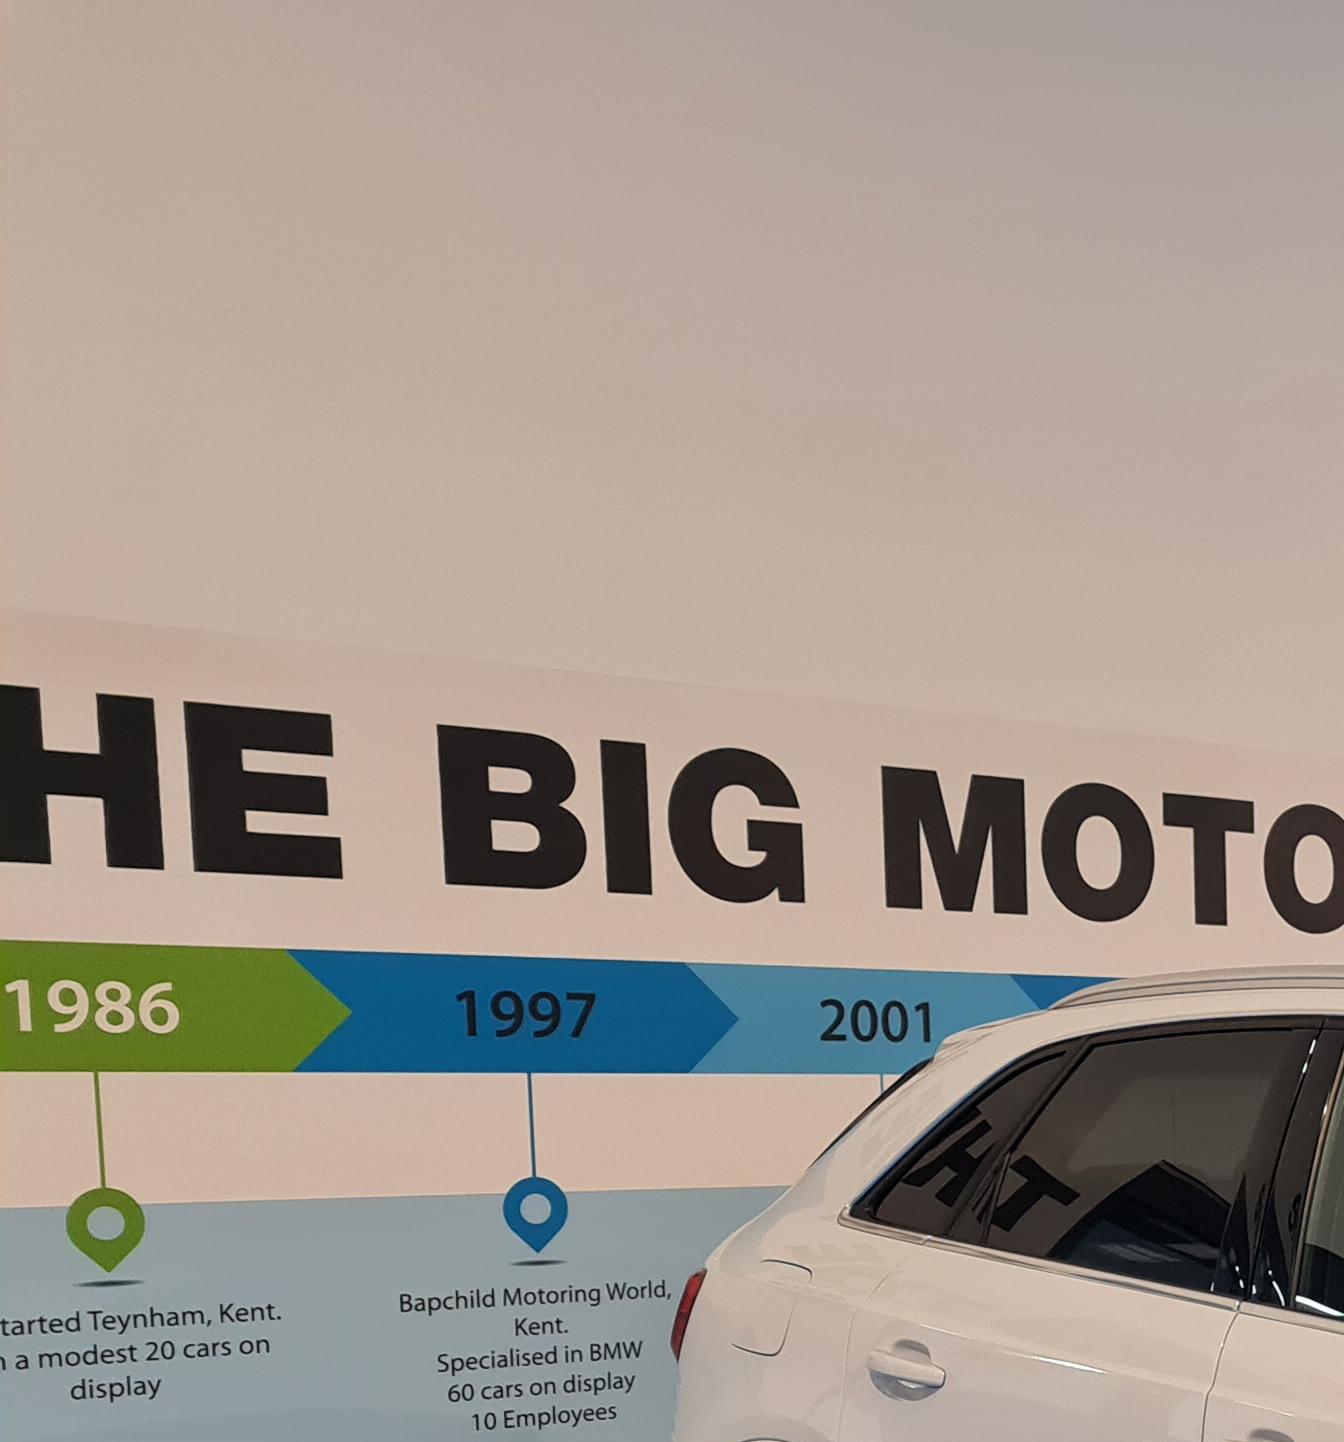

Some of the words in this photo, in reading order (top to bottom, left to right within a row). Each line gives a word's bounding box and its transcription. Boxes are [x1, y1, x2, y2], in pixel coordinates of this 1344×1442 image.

[0, 684, 343, 879] HE
[437, 724, 806, 904] BIG
[3, 979, 181, 1035] 1986
[455, 988, 597, 1040] 1997
[819, 998, 934, 1045] 2001
[399, 1288, 496, 1315] Bapchild
[503, 1285, 601, 1307] Motoring
[605, 1280, 672, 1301] World,
[0, 1311, 81, 1336] tarted
[87, 1307, 212, 1335] Teynham,
[219, 1303, 282, 1324] Kent.
[514, 1317, 569, 1336] Kent.
[15, 1354, 30, 1370] a
[39, 1344, 138, 1369] modest
[145, 1340, 175, 1362] 20
[183, 1338, 232, 1359] cars
[239, 1338, 271, 1355] on
[437, 1346, 558, 1376] Specialised
[564, 1346, 583, 1364] in
[590, 1340, 643, 1362] BMW
[70, 1376, 162, 1403] display
[448, 1383, 474, 1403] 60
[481, 1381, 523, 1401] cars
[529, 1380, 556, 1396] on
[563, 1372, 635, 1395] display
[472, 1412, 497, 1431] 10
[504, 1405, 617, 1430] Employees
